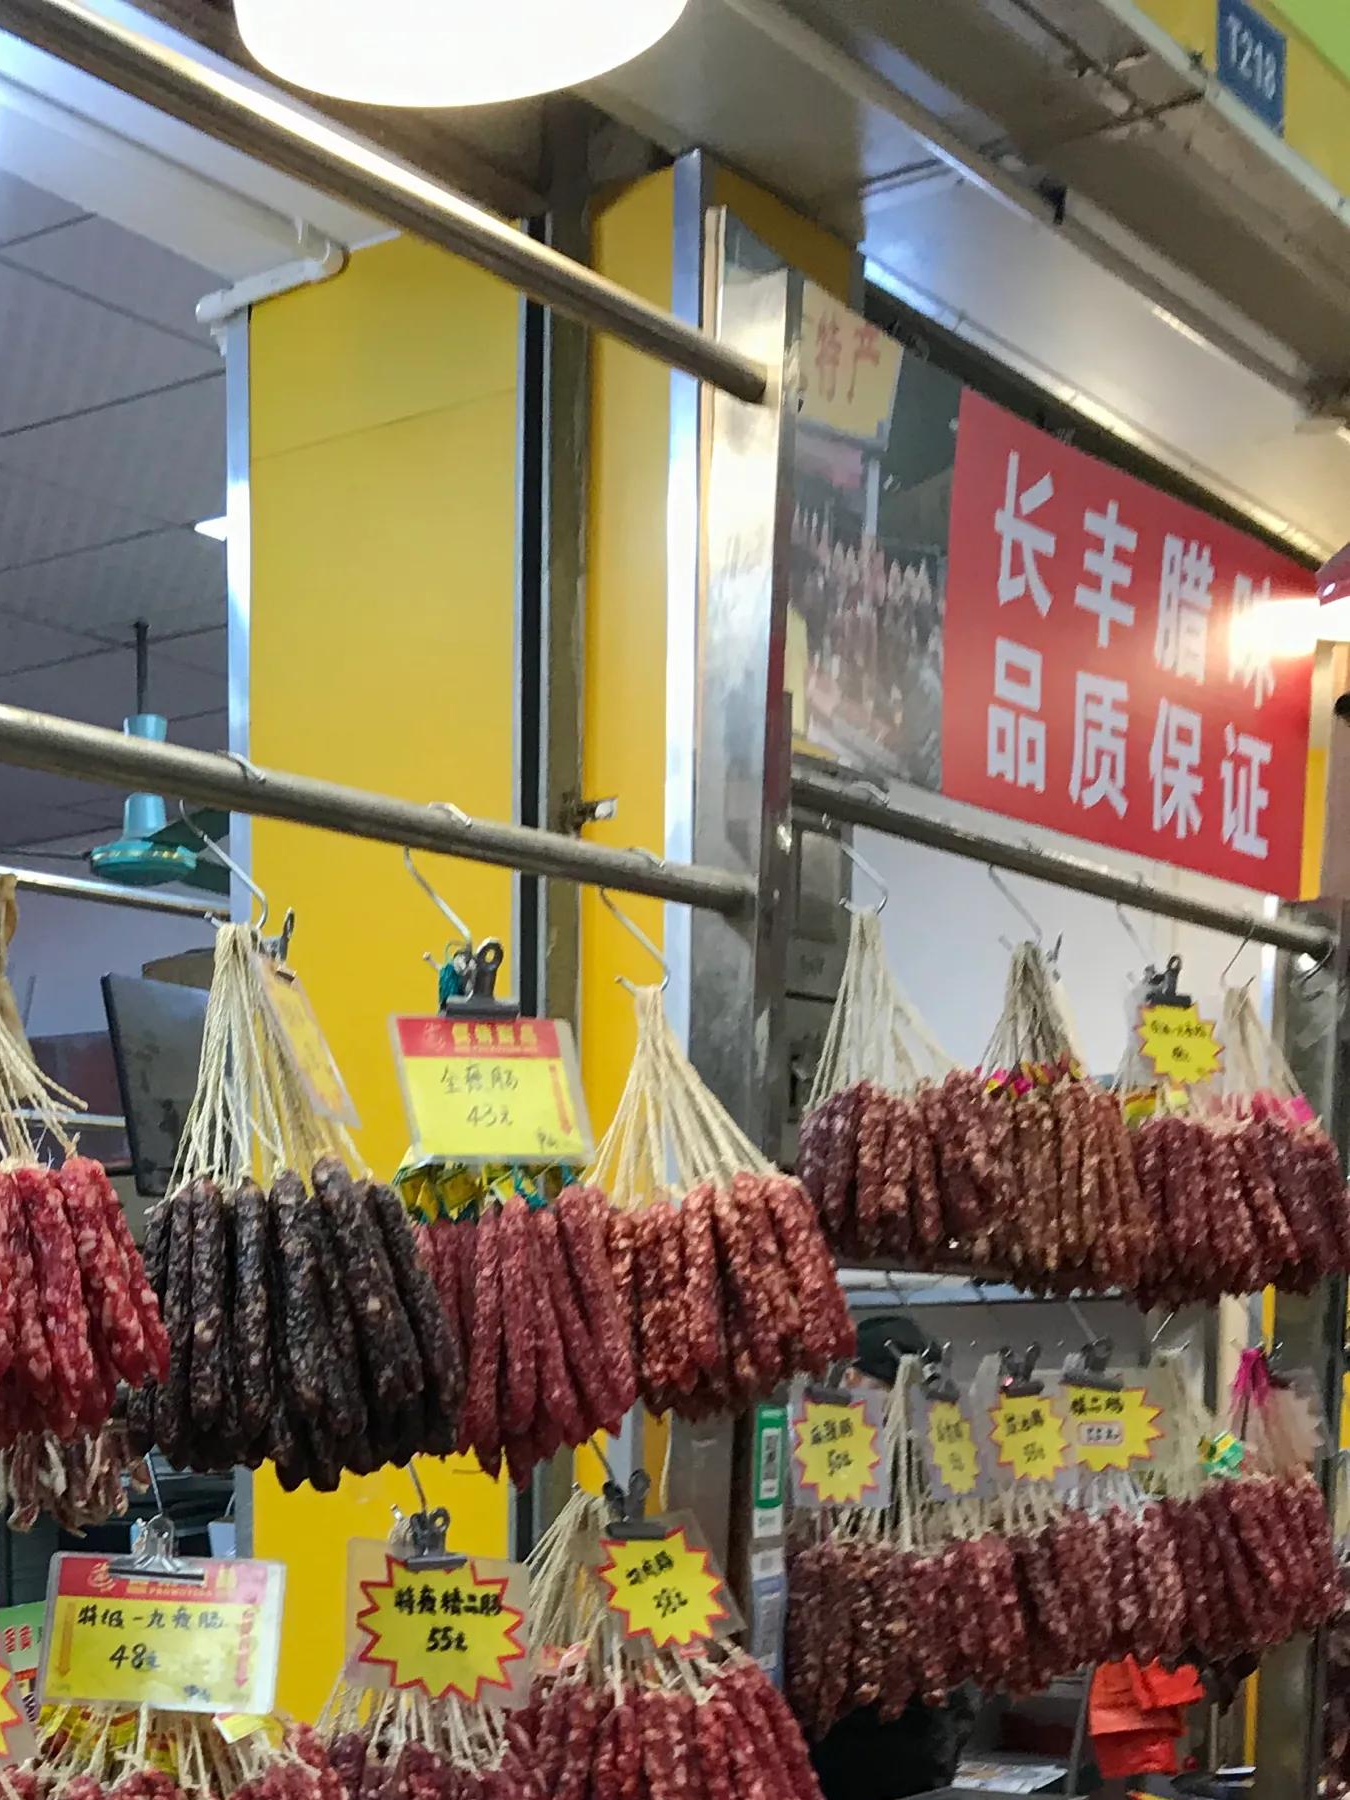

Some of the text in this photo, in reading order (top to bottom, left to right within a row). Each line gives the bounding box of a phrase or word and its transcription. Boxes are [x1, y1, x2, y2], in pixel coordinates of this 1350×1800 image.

[986, 636, 1272, 860] 品质保证
[108, 1642, 161, 1670] 48元
